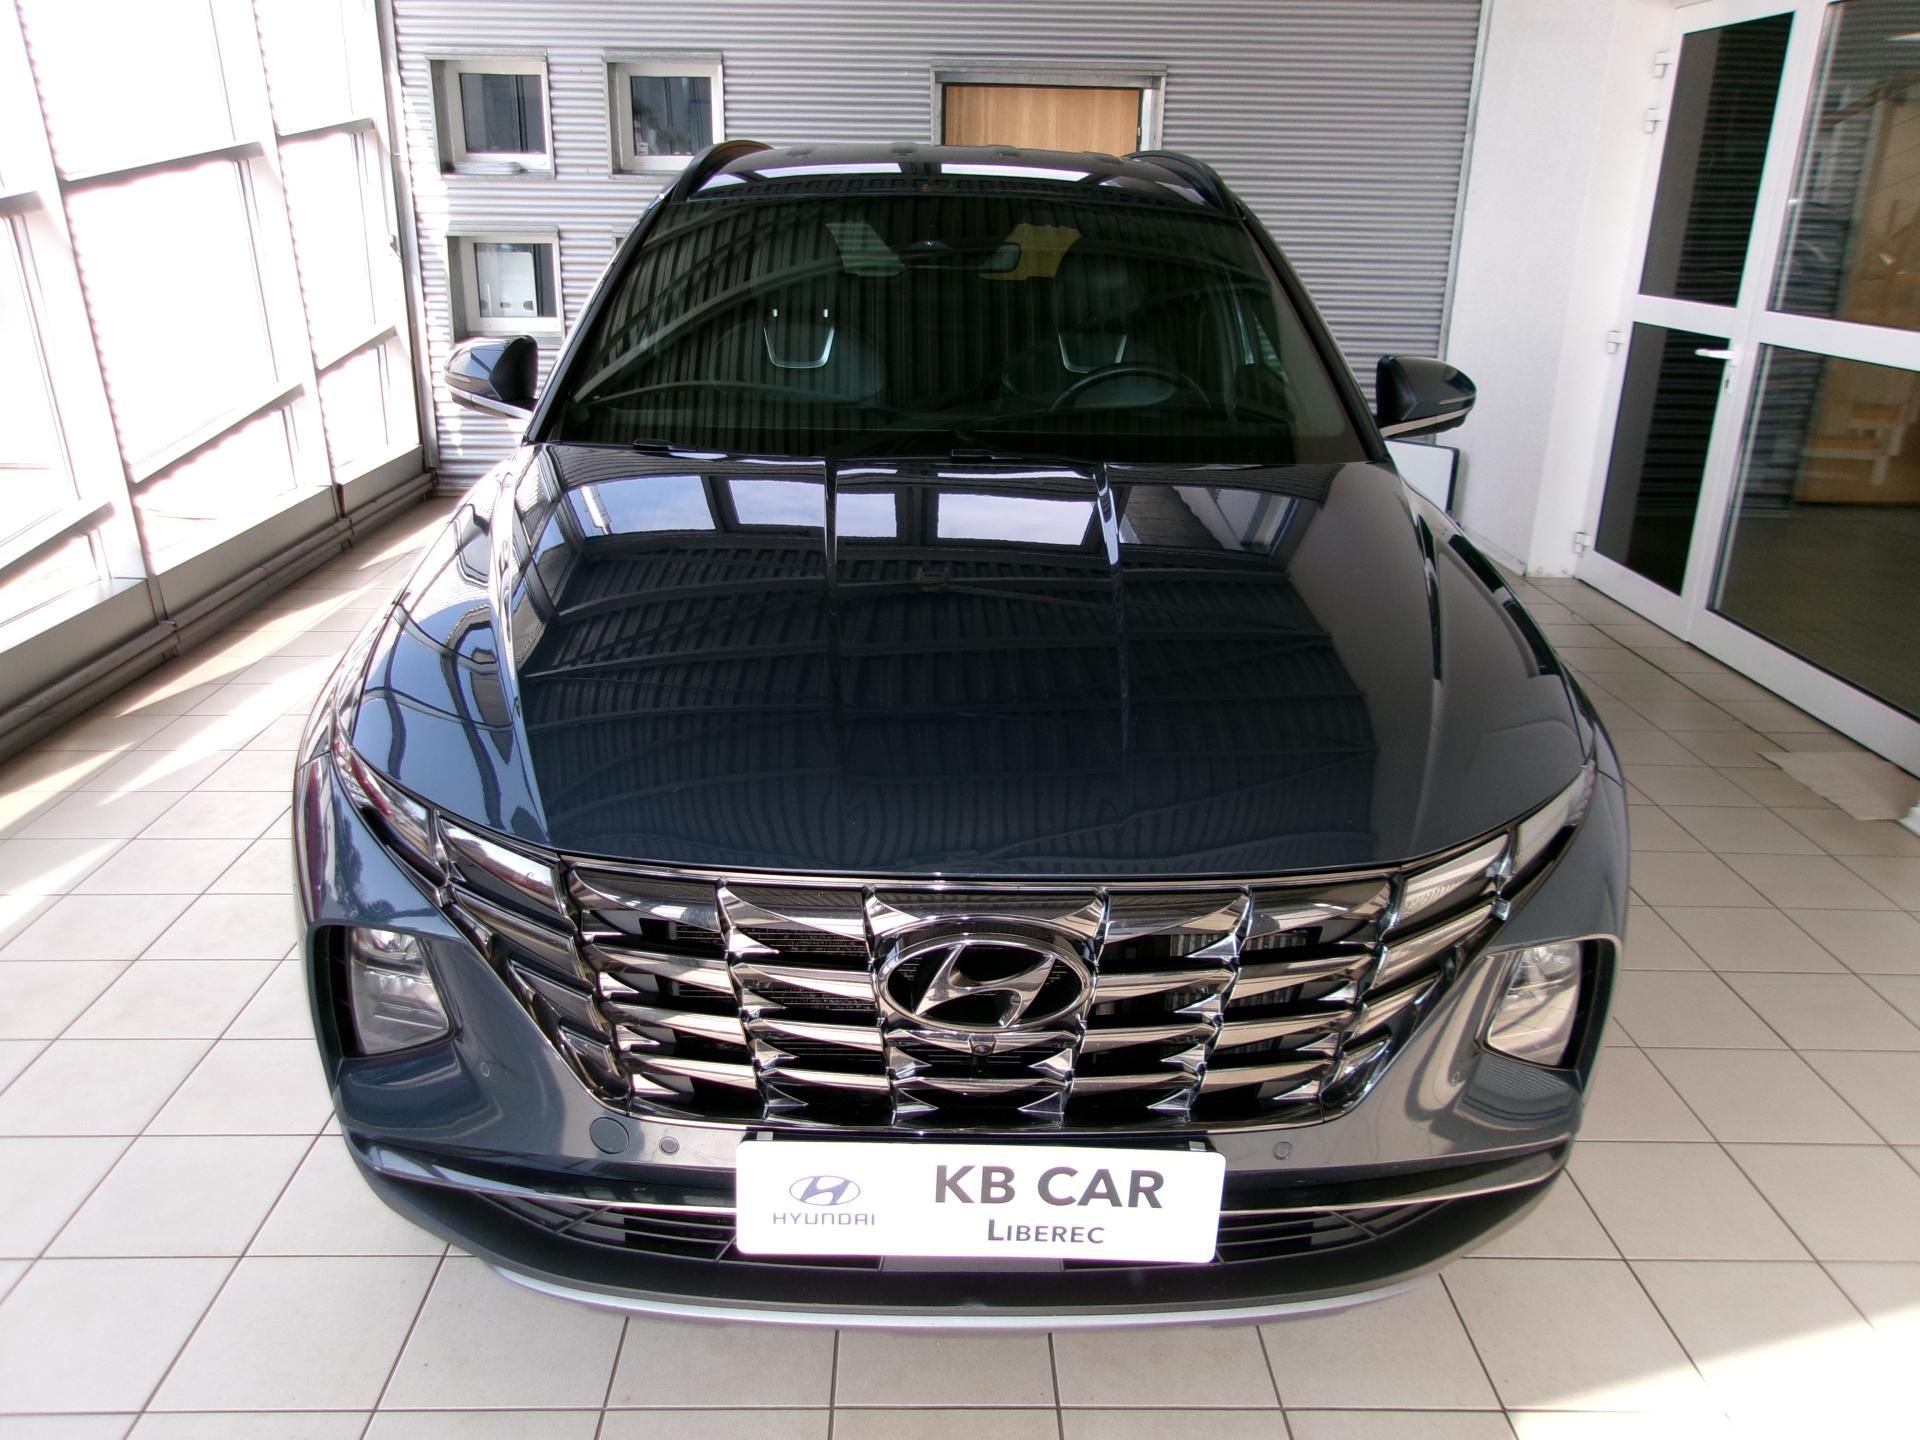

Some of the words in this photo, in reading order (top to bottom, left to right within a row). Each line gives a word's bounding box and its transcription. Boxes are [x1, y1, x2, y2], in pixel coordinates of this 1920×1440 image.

[935, 1165, 1015, 1204] KB
[1037, 1166, 1165, 1209] CAR
[772, 1212, 875, 1226] HYUNDAI
[987, 1219, 1104, 1244] LIBEREC
